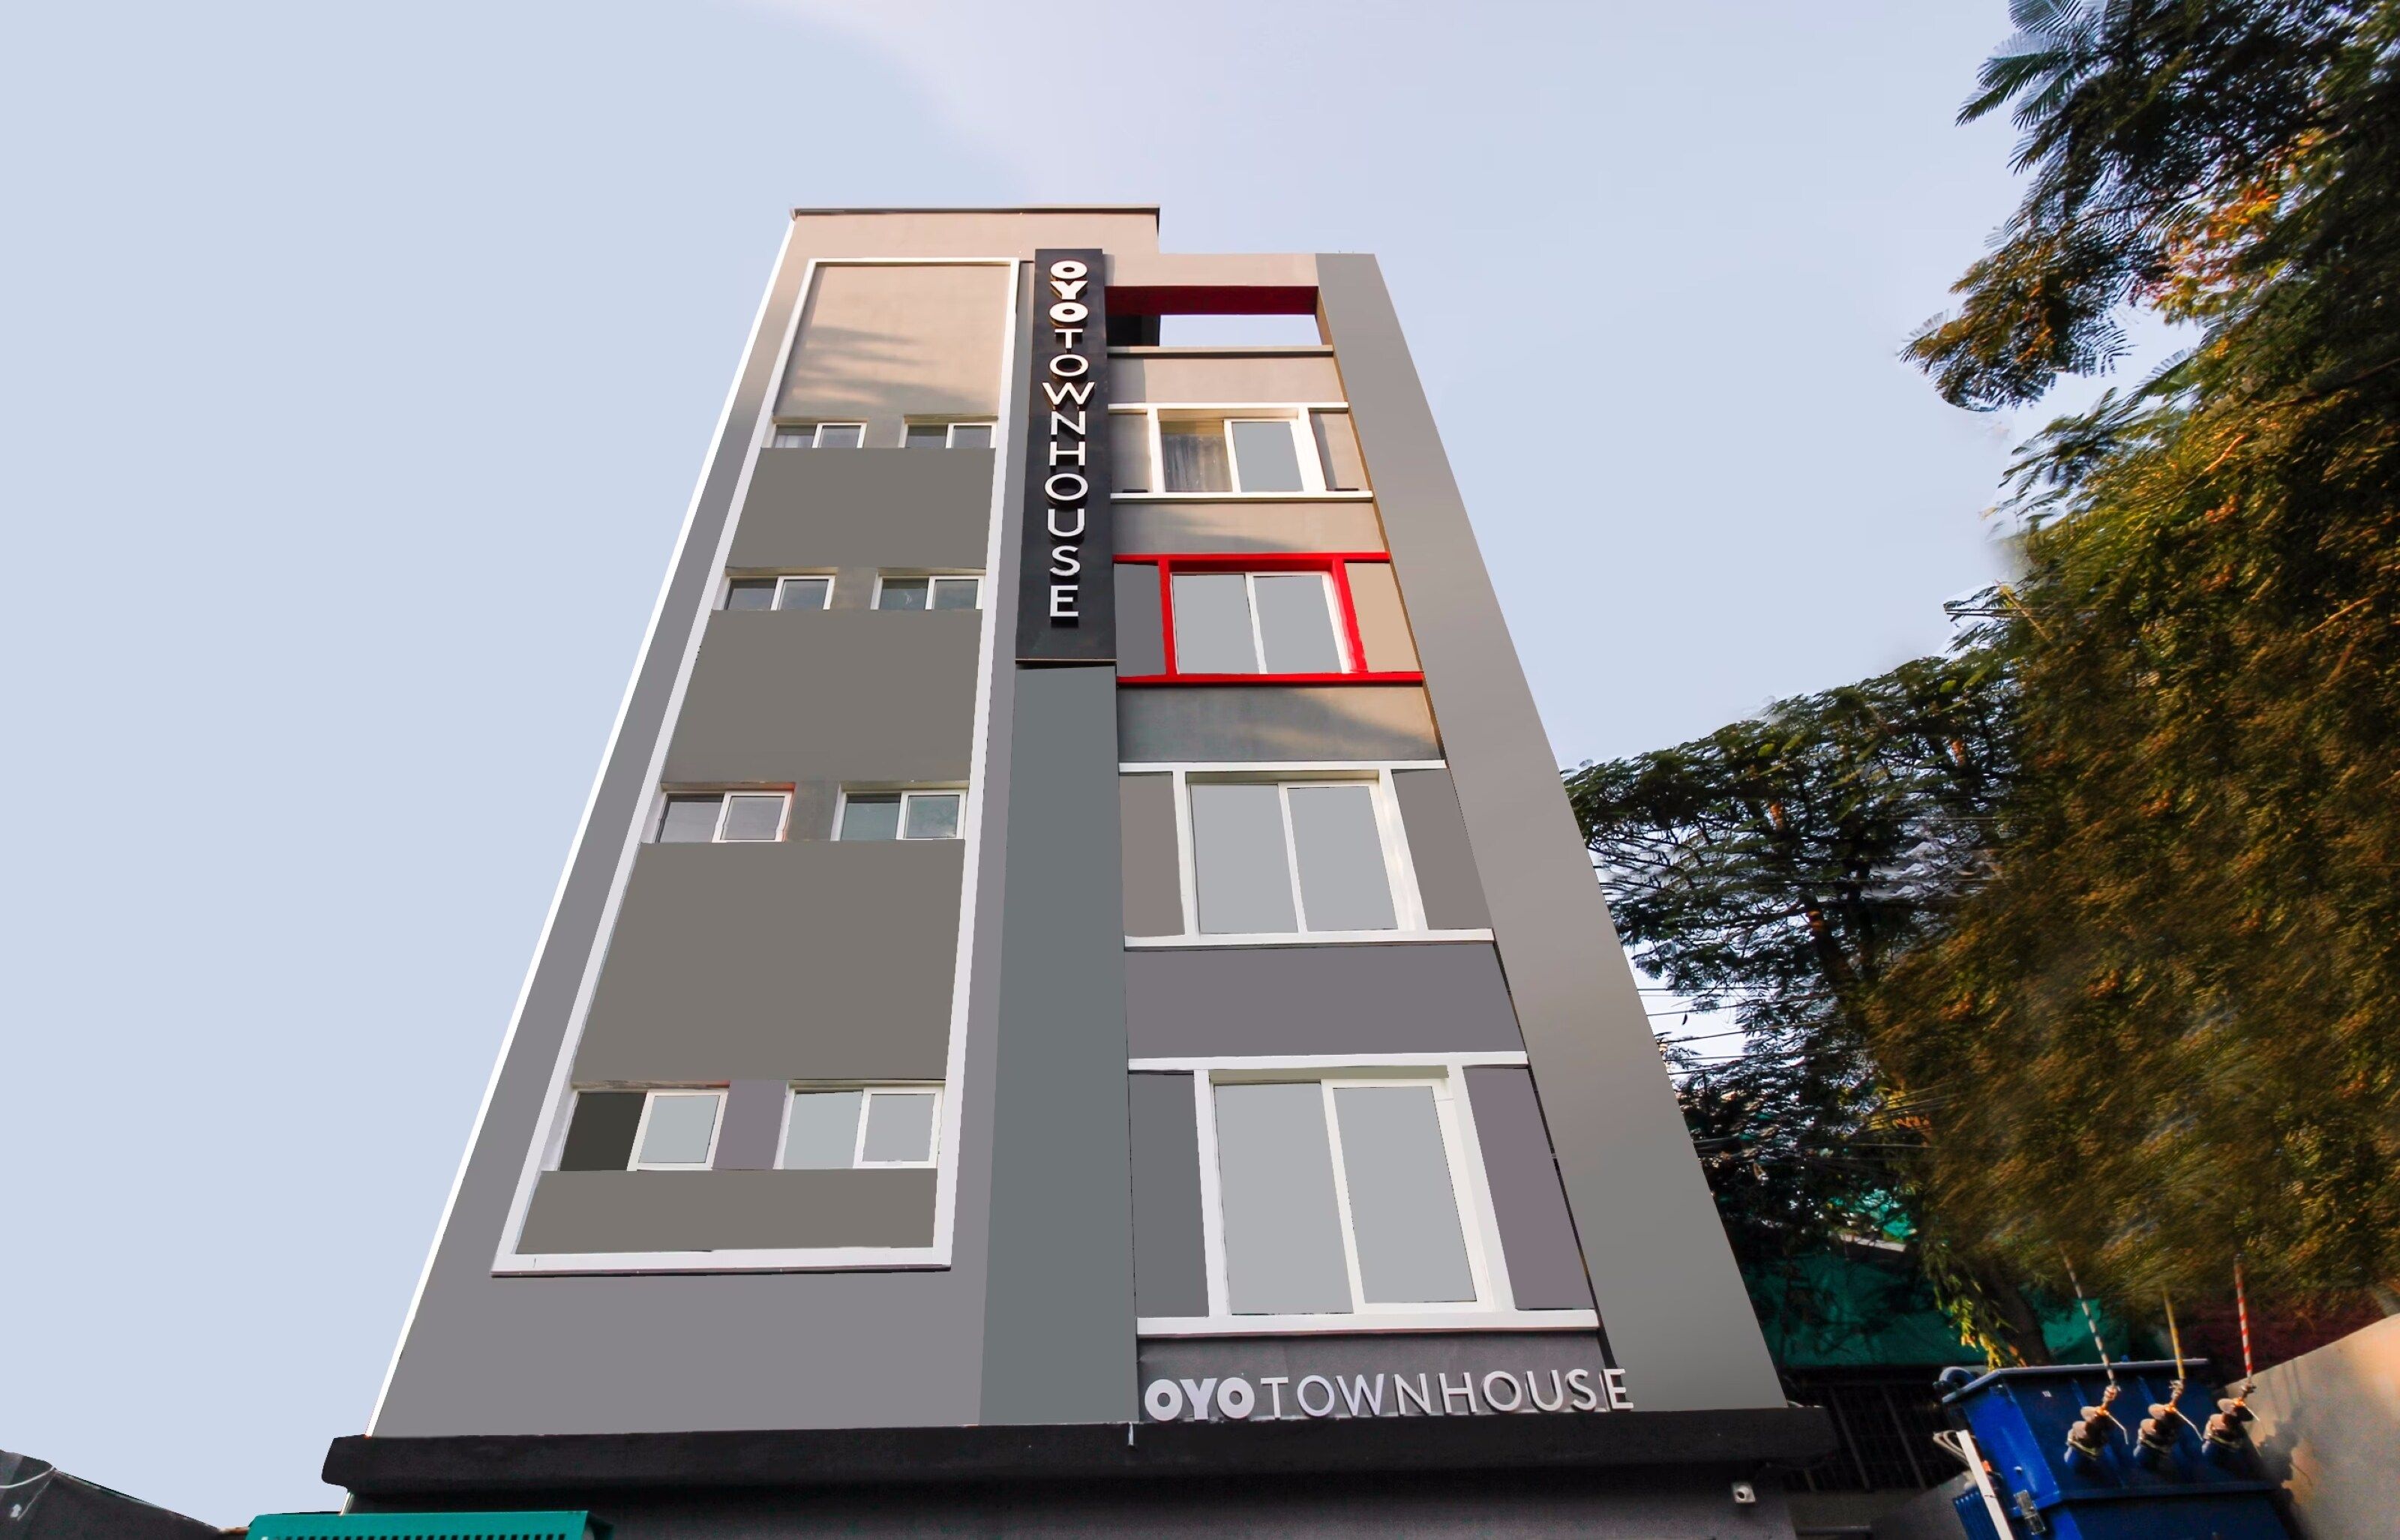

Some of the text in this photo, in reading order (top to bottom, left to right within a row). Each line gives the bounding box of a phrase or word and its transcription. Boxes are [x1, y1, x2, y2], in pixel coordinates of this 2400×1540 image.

[1042, 259, 1096, 618] OYO TOWNHOUSE
[1144, 1368, 1634, 1422] OYO TOWNHOUSE
